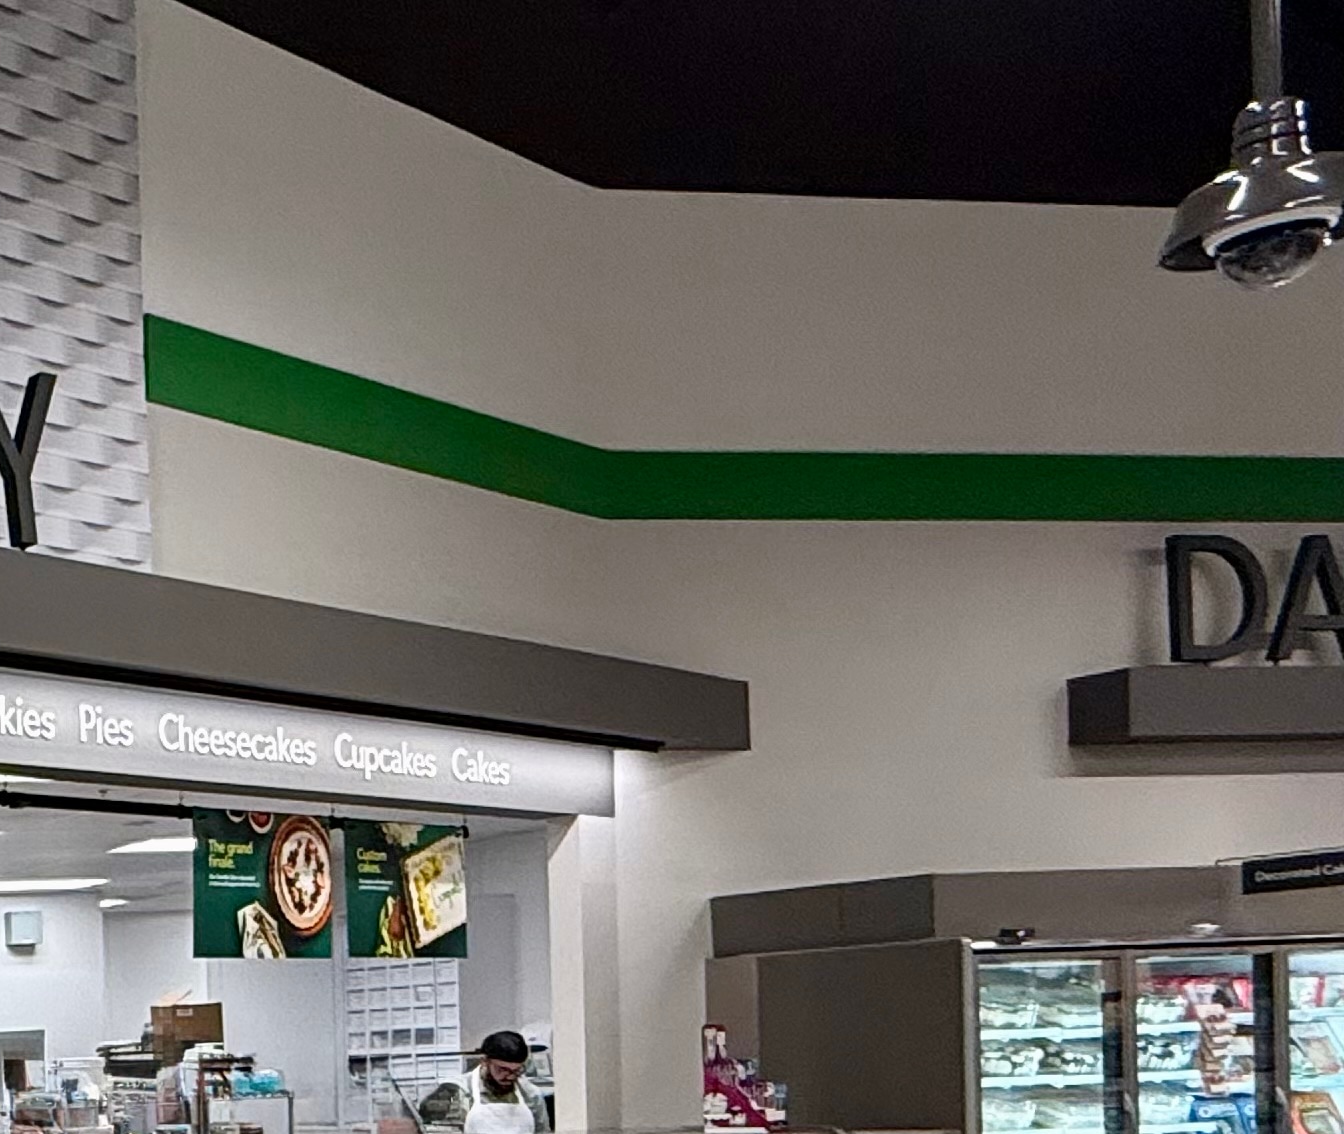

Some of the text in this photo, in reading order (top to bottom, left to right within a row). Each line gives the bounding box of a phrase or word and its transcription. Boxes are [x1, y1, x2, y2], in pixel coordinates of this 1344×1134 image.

[77, 702, 135, 748] Pies
[157, 712, 317, 768] Cheesecakes
[333, 731, 439, 780] Cupcakes
[450, 748, 512, 788] Cakes
